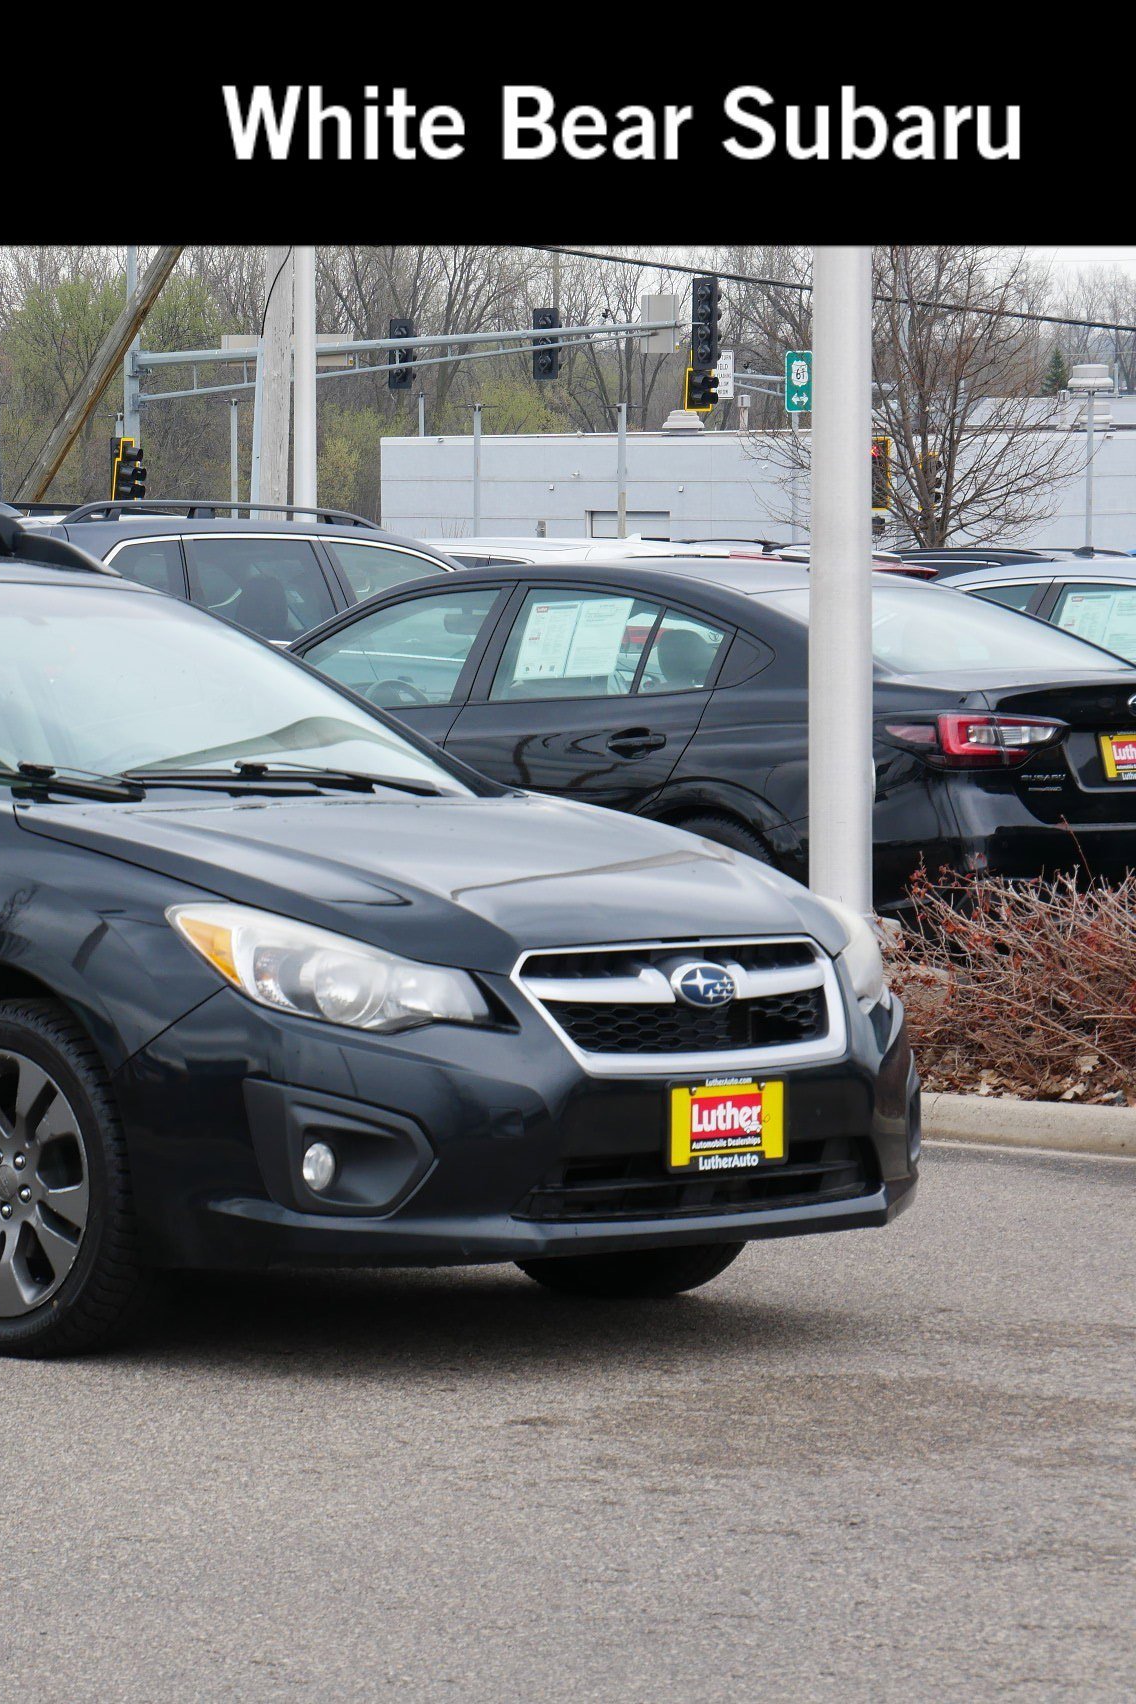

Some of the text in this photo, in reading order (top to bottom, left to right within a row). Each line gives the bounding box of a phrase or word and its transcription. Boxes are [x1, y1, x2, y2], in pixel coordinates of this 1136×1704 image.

[795, 368, 806, 380] 61
[1112, 743, 1136, 761] Luth
[705, 1076, 753, 1088] LutherAuto.com
[691, 1100, 762, 1133] Luther
[691, 1134, 761, 1150] Automobile Dealerships
[698, 1152, 759, 1171] LutherAuto
